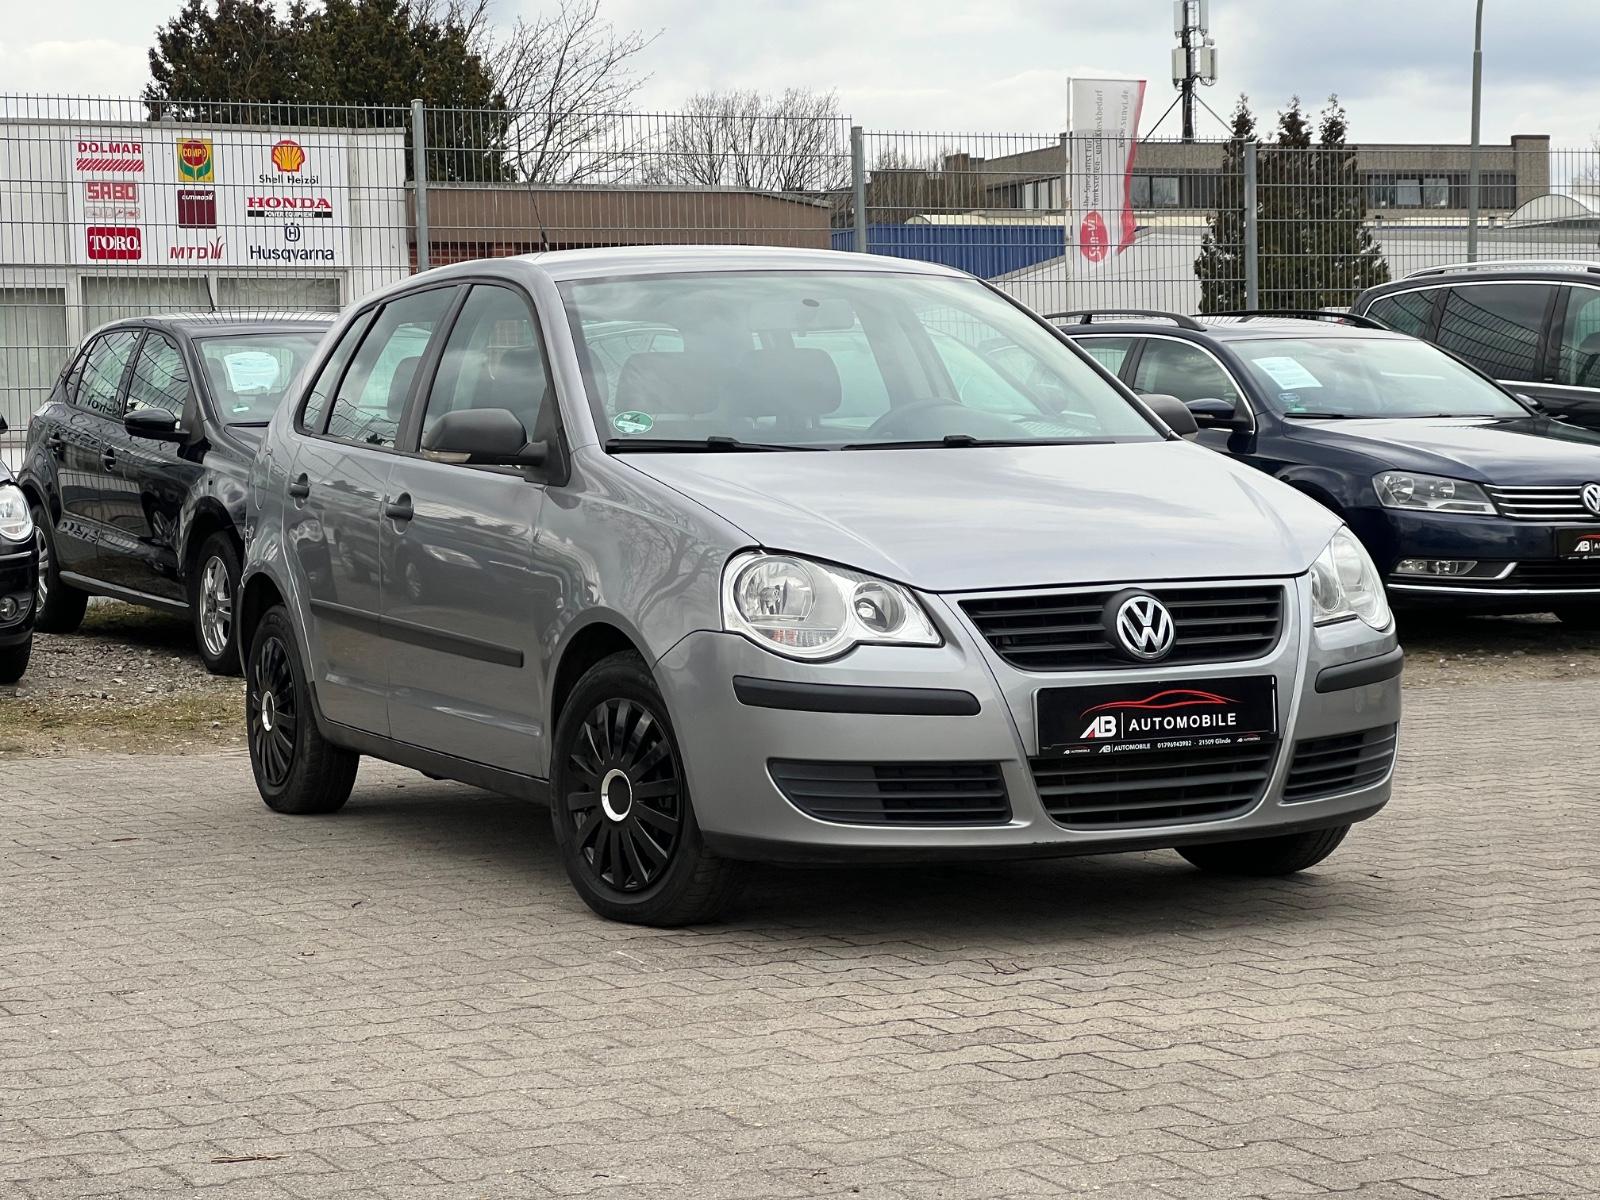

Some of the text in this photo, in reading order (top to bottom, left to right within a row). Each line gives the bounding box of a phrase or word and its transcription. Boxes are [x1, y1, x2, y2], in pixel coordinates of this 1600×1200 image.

[78, 142, 142, 154] DOLMAR
[183, 148, 207, 158] COMPO
[259, 174, 319, 185] Shell Heizöl
[87, 182, 137, 200] SABO
[247, 197, 332, 209] HONDA
[90, 235, 138, 251] TORO
[170, 246, 208, 259] MTD
[250, 245, 335, 263] Husqvarna
[1117, 596, 1174, 660] VW
[1080, 712, 1238, 739] AB AUTOMOBILE
[1113, 742, 1151, 752] AUTOMOBILE
